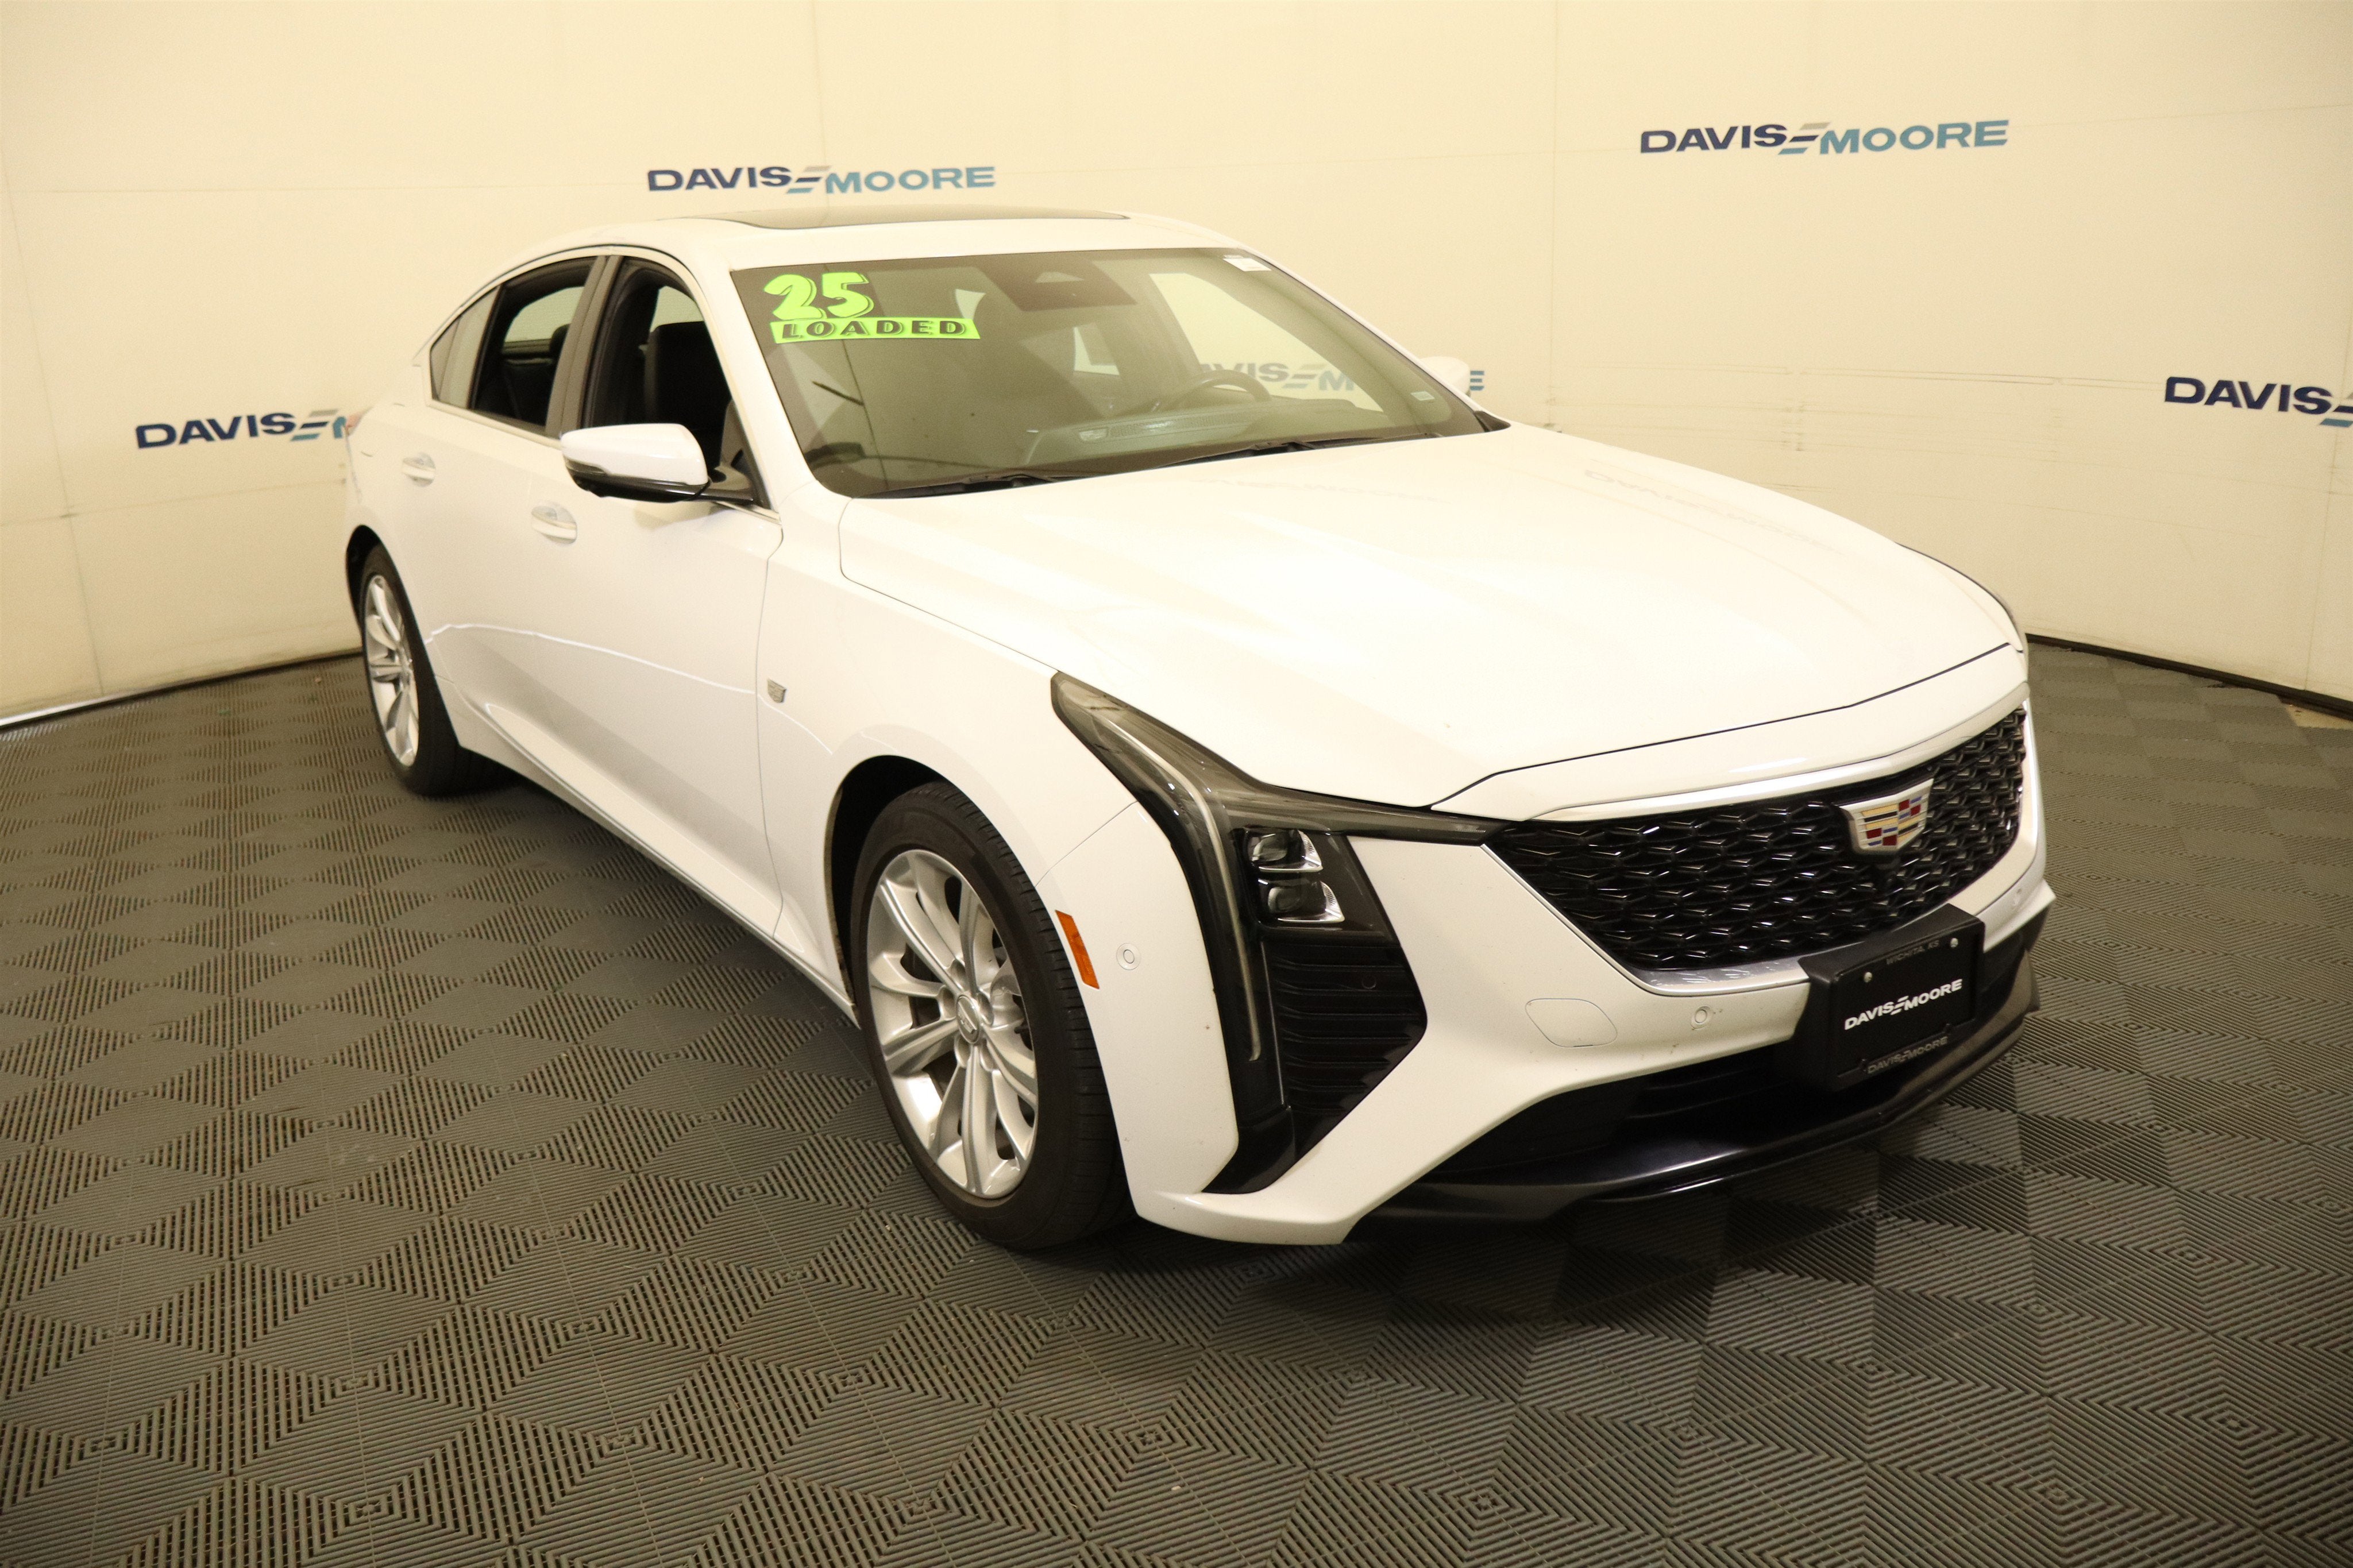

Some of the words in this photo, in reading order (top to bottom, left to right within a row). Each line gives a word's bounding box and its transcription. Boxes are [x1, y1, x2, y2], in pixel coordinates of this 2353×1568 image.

[1640, 123, 1787, 153] DAVIS
[1819, 119, 2009, 155] MOORE
[647, 166, 791, 191] DAVIS
[825, 166, 996, 194] MOORE
[763, 272, 874, 320] 25
[780, 320, 968, 340] LOADED
[2164, 376, 2333, 415] DAVIS
[135, 412, 296, 449] DAVIS
[1844, 1001, 1895, 1030] DAVIS
[1904, 978, 1963, 1011] MOORE
